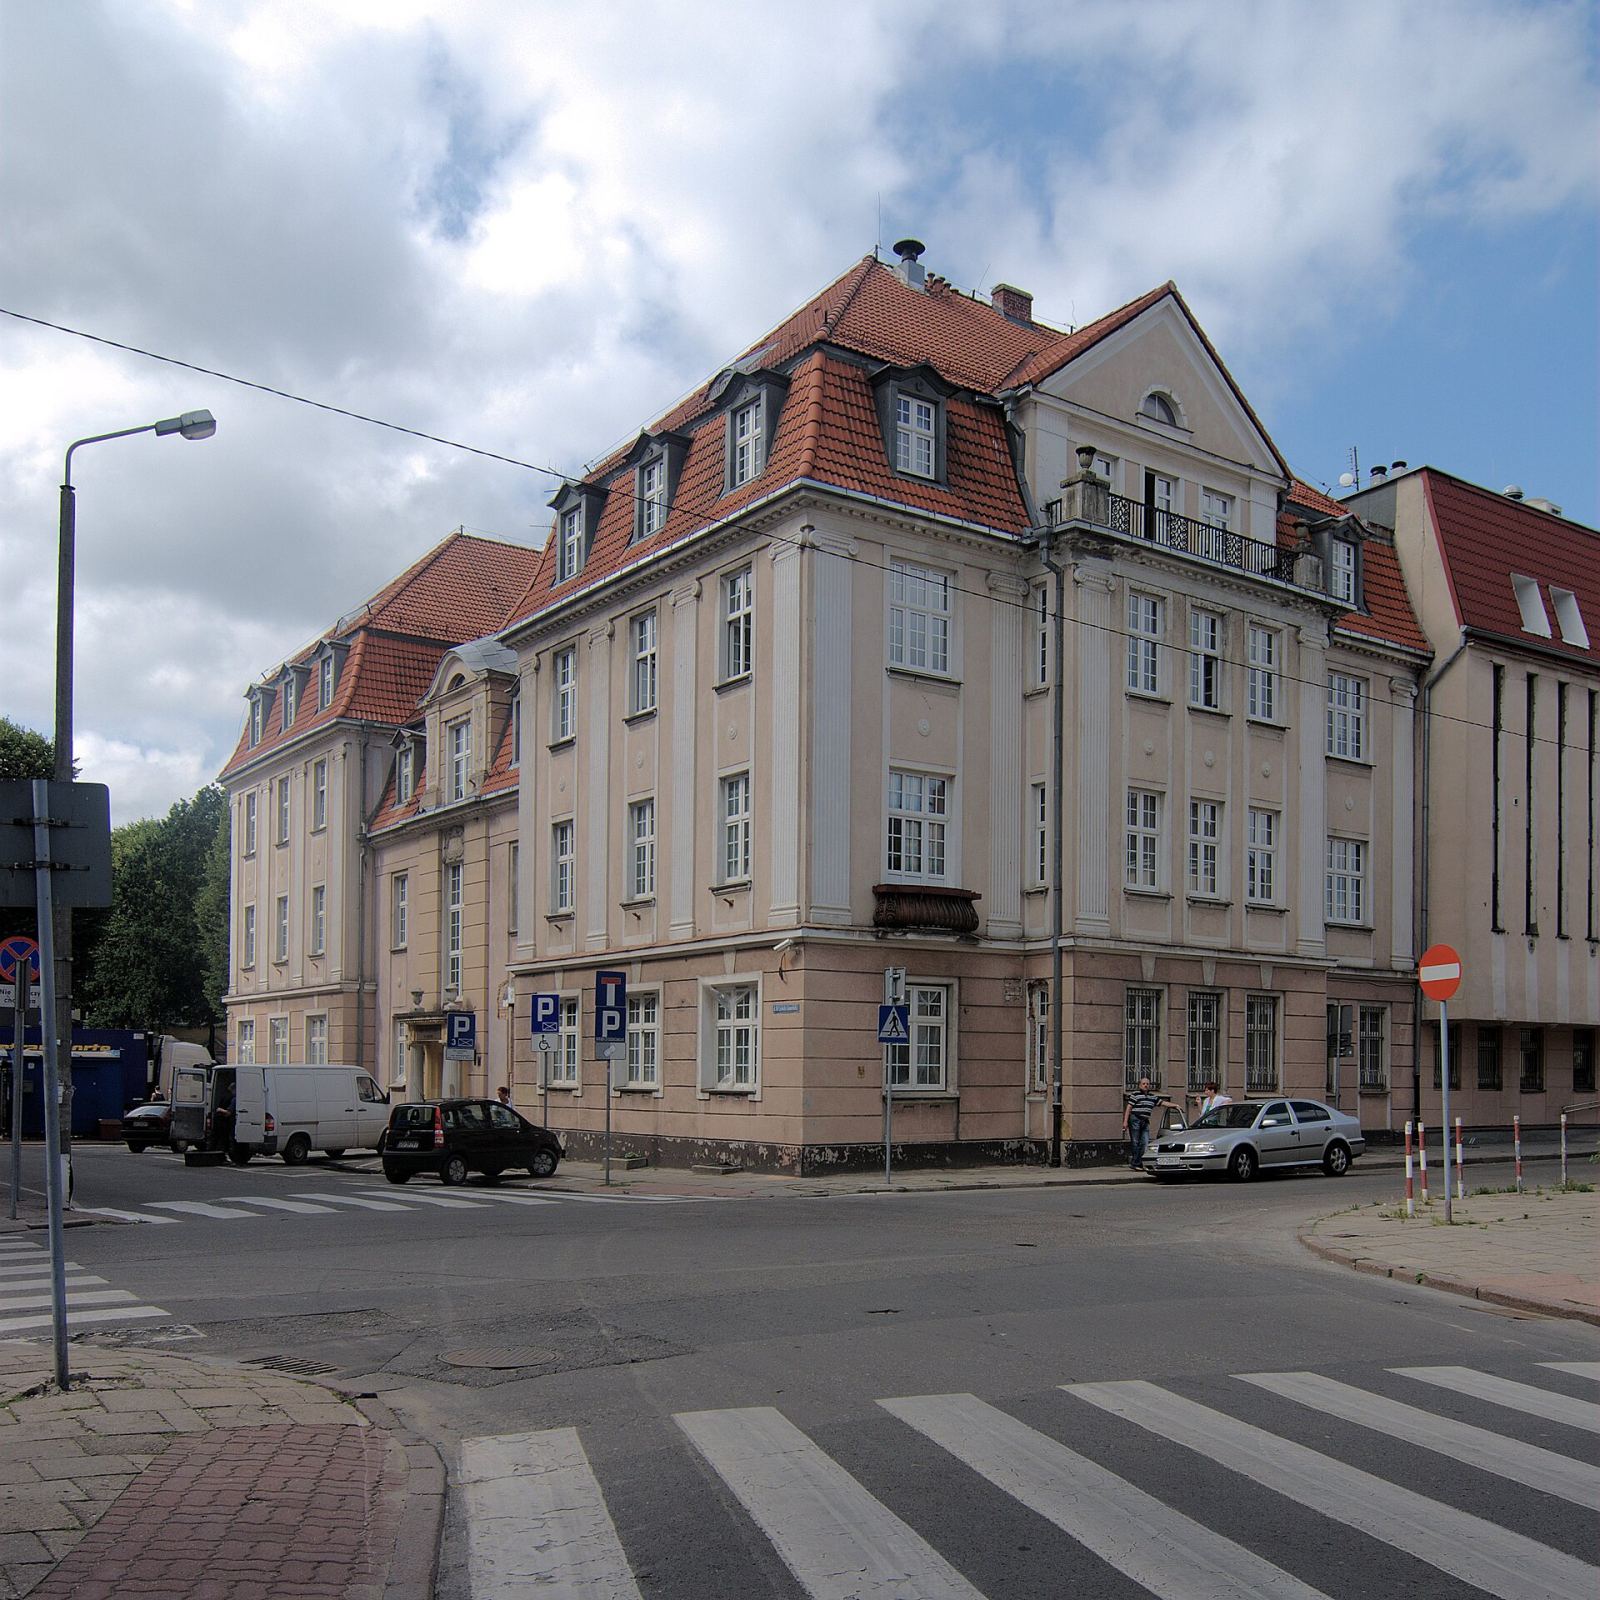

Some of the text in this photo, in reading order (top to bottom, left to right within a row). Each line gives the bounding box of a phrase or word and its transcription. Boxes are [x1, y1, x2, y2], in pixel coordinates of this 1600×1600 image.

[537, 997, 554, 1022] P
[453, 1016, 470, 1038] P
[602, 1010, 620, 1038] P
[451, 1038, 457, 1046] 3
